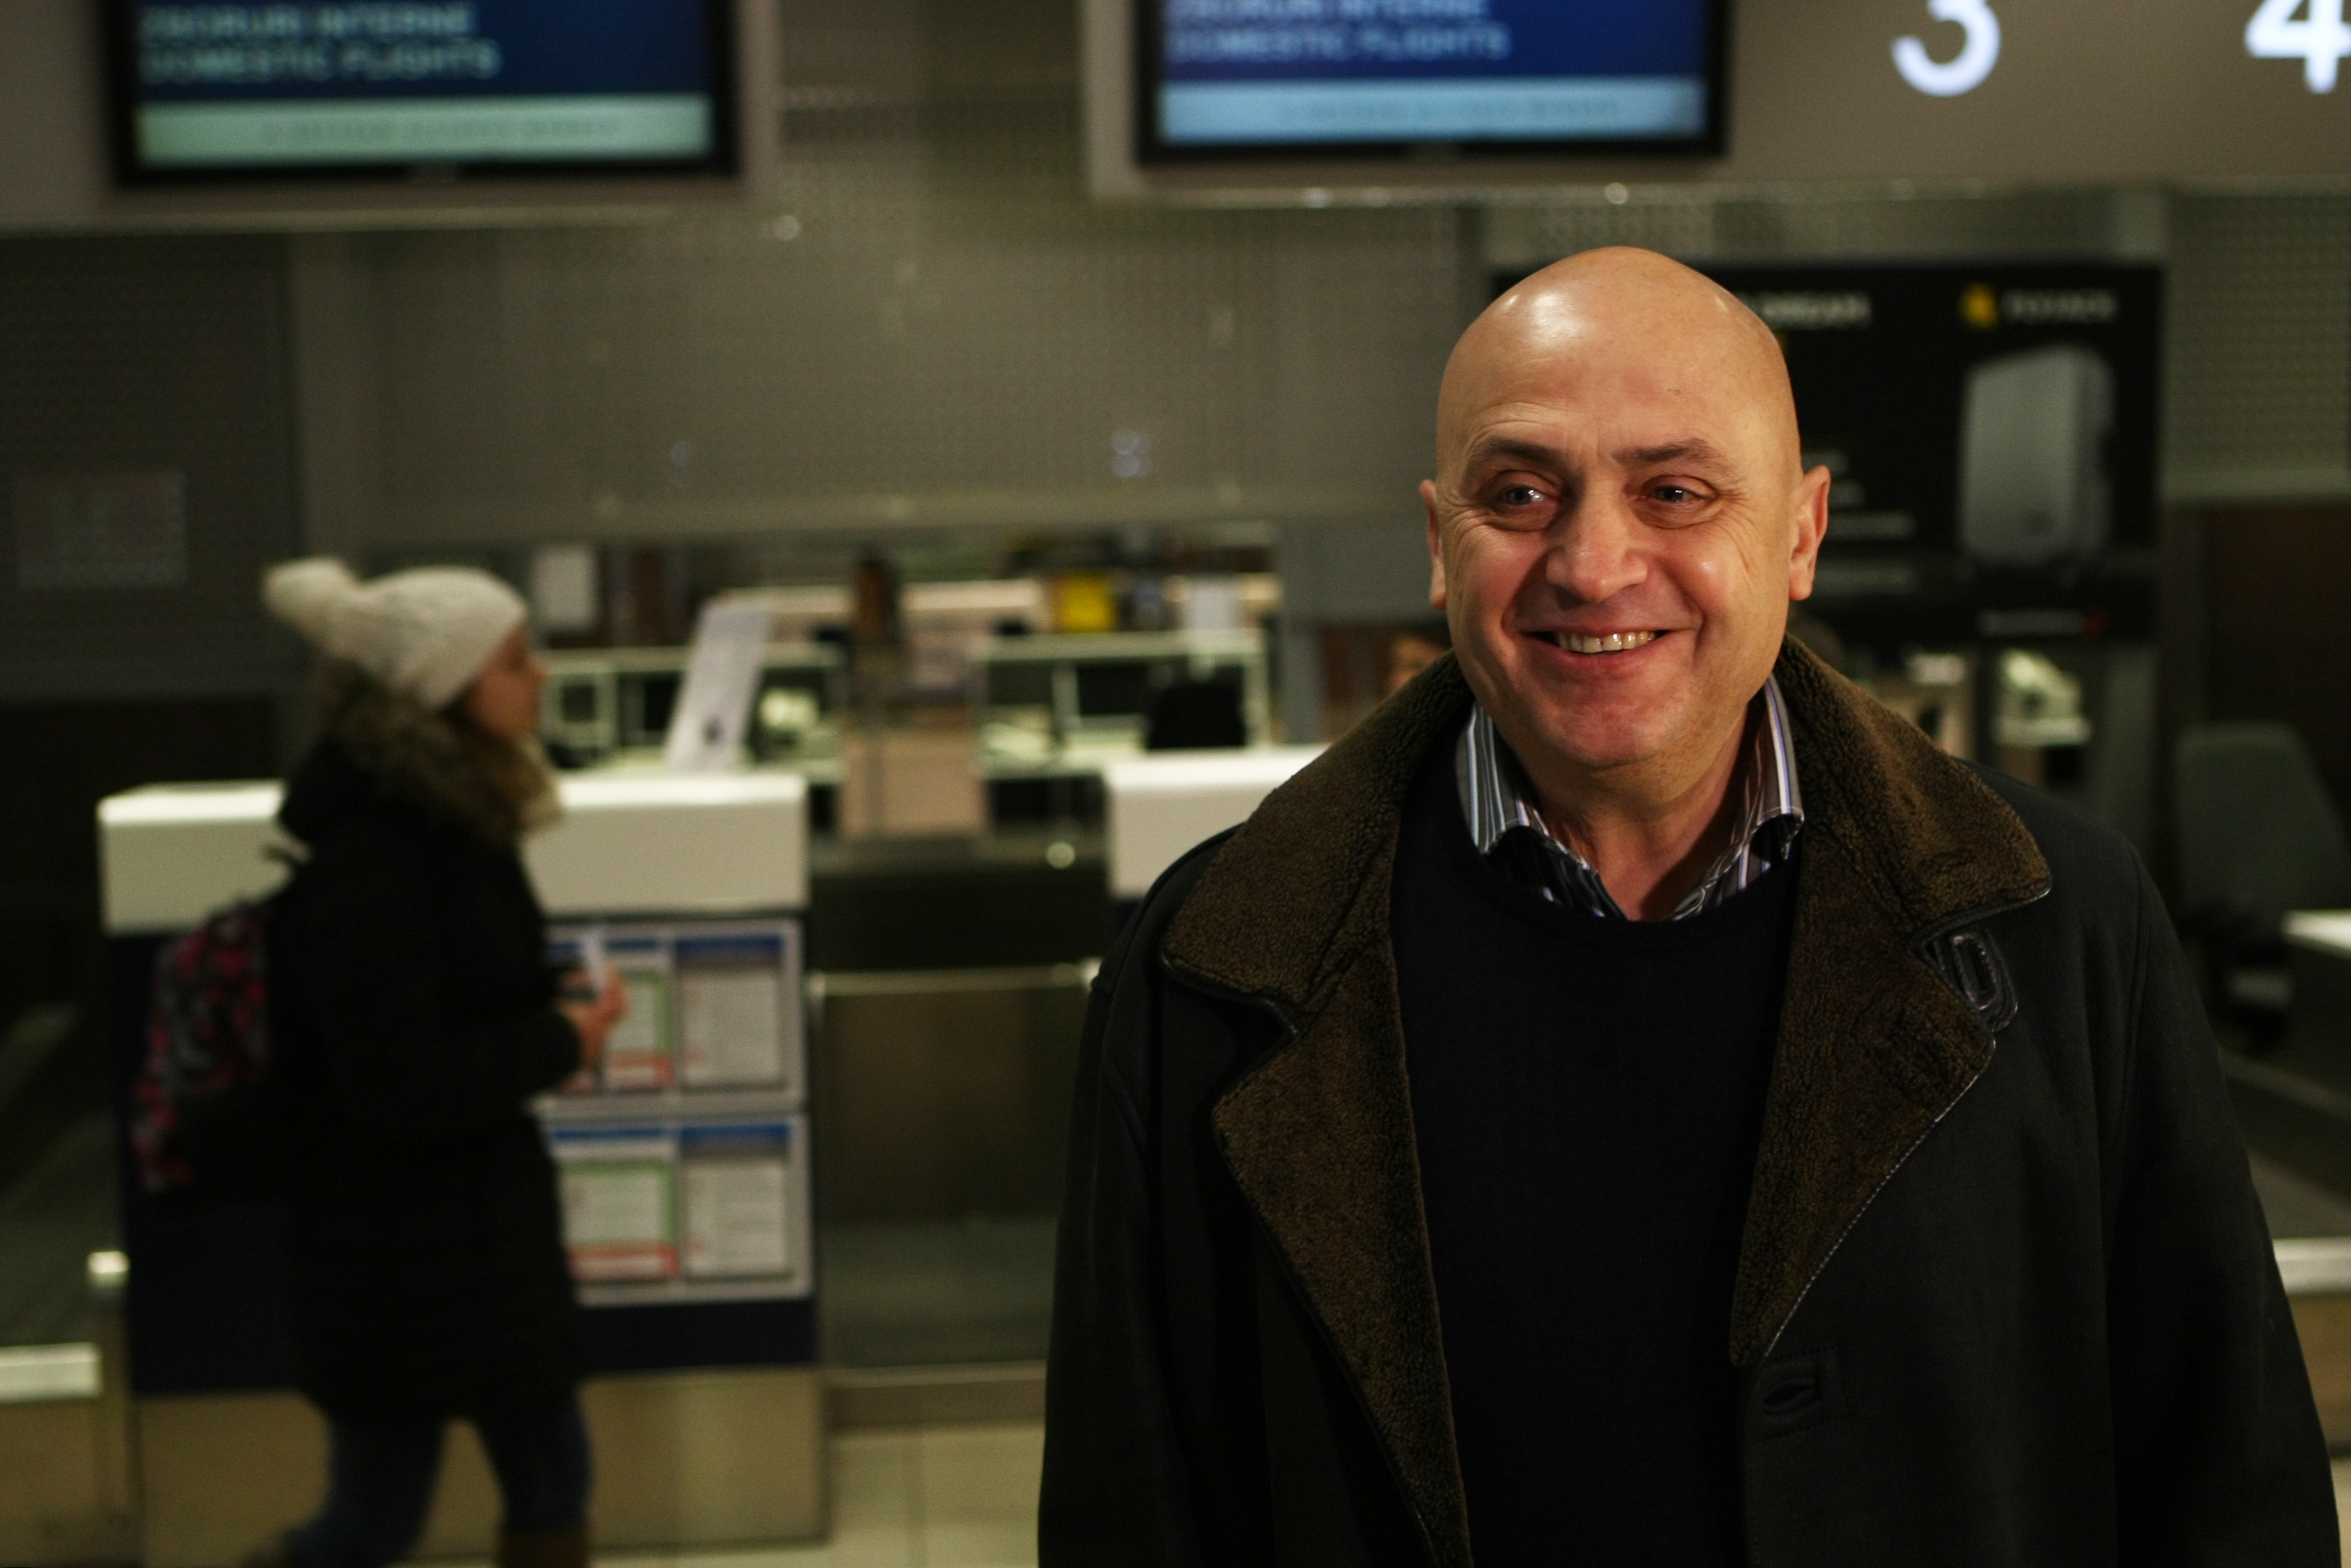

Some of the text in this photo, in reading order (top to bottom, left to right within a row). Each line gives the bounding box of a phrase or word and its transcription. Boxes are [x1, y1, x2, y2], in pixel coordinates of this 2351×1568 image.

[142, 40, 501, 82] DOMESTIC FLIGHTS
[1891, 0, 2002, 96] 3
[2244, 0, 2351, 95] 4
